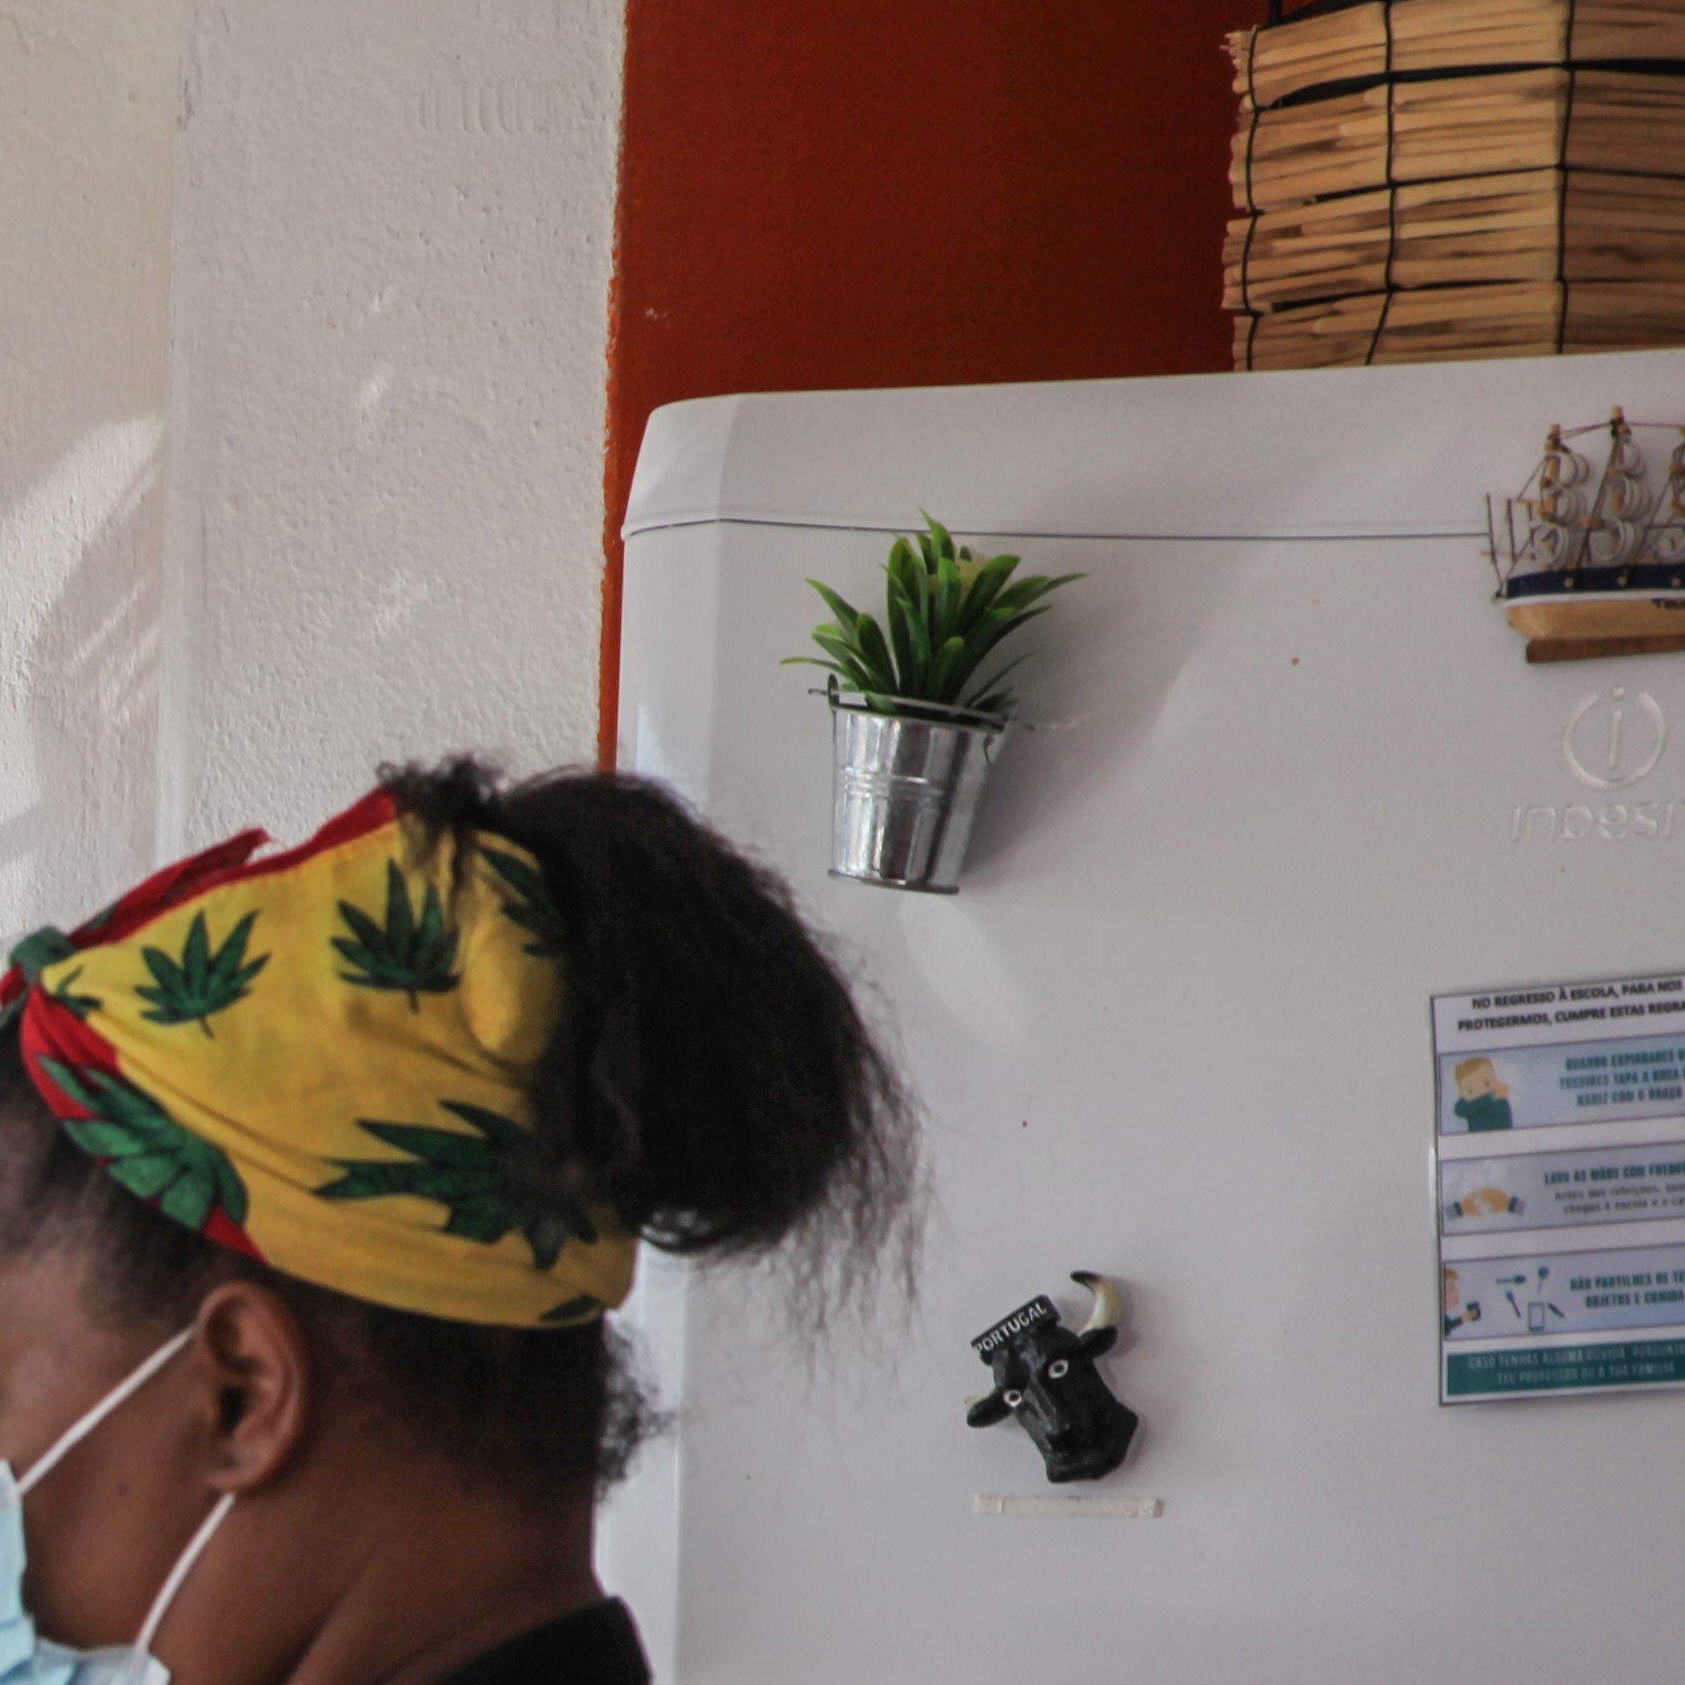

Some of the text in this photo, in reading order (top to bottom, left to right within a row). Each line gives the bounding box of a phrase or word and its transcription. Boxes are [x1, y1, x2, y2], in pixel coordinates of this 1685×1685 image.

[1473, 998, 1490, 1009] NO
[1495, 991, 1555, 1008] REGRESSO
[1571, 986, 1619, 1000] ESCOLA,
[1622, 982, 1654, 995] PARA
[1658, 979, 1683, 991] NOS
[1458, 1001, 1685, 1031] PROTEGERMOS, CUMPRE ESTAS REGRA
[974, 1303, 1047, 1355] PORTUGAL
